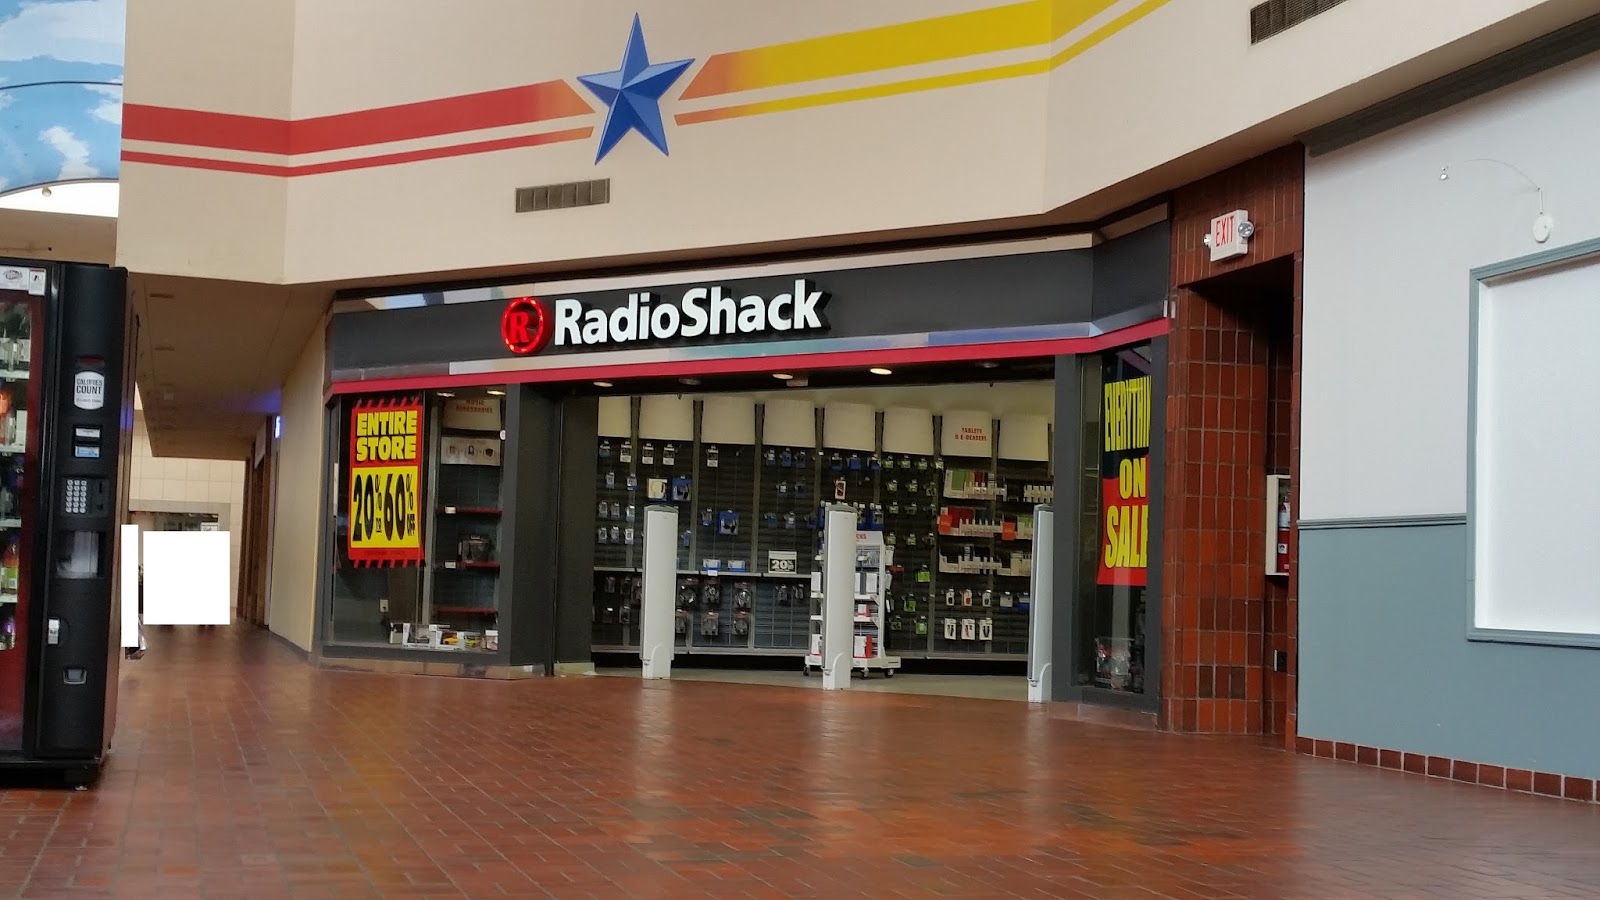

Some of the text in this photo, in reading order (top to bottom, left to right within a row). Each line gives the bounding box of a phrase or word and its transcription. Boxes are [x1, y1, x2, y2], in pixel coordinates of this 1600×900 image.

[1216, 215, 1234, 247] EXIT
[555, 279, 824, 346] RadioShack
[76, 385, 102, 394] COUNT
[356, 410, 418, 436] ENTIRE
[356, 435, 417, 461] STORE
[1119, 457, 1146, 499] ON
